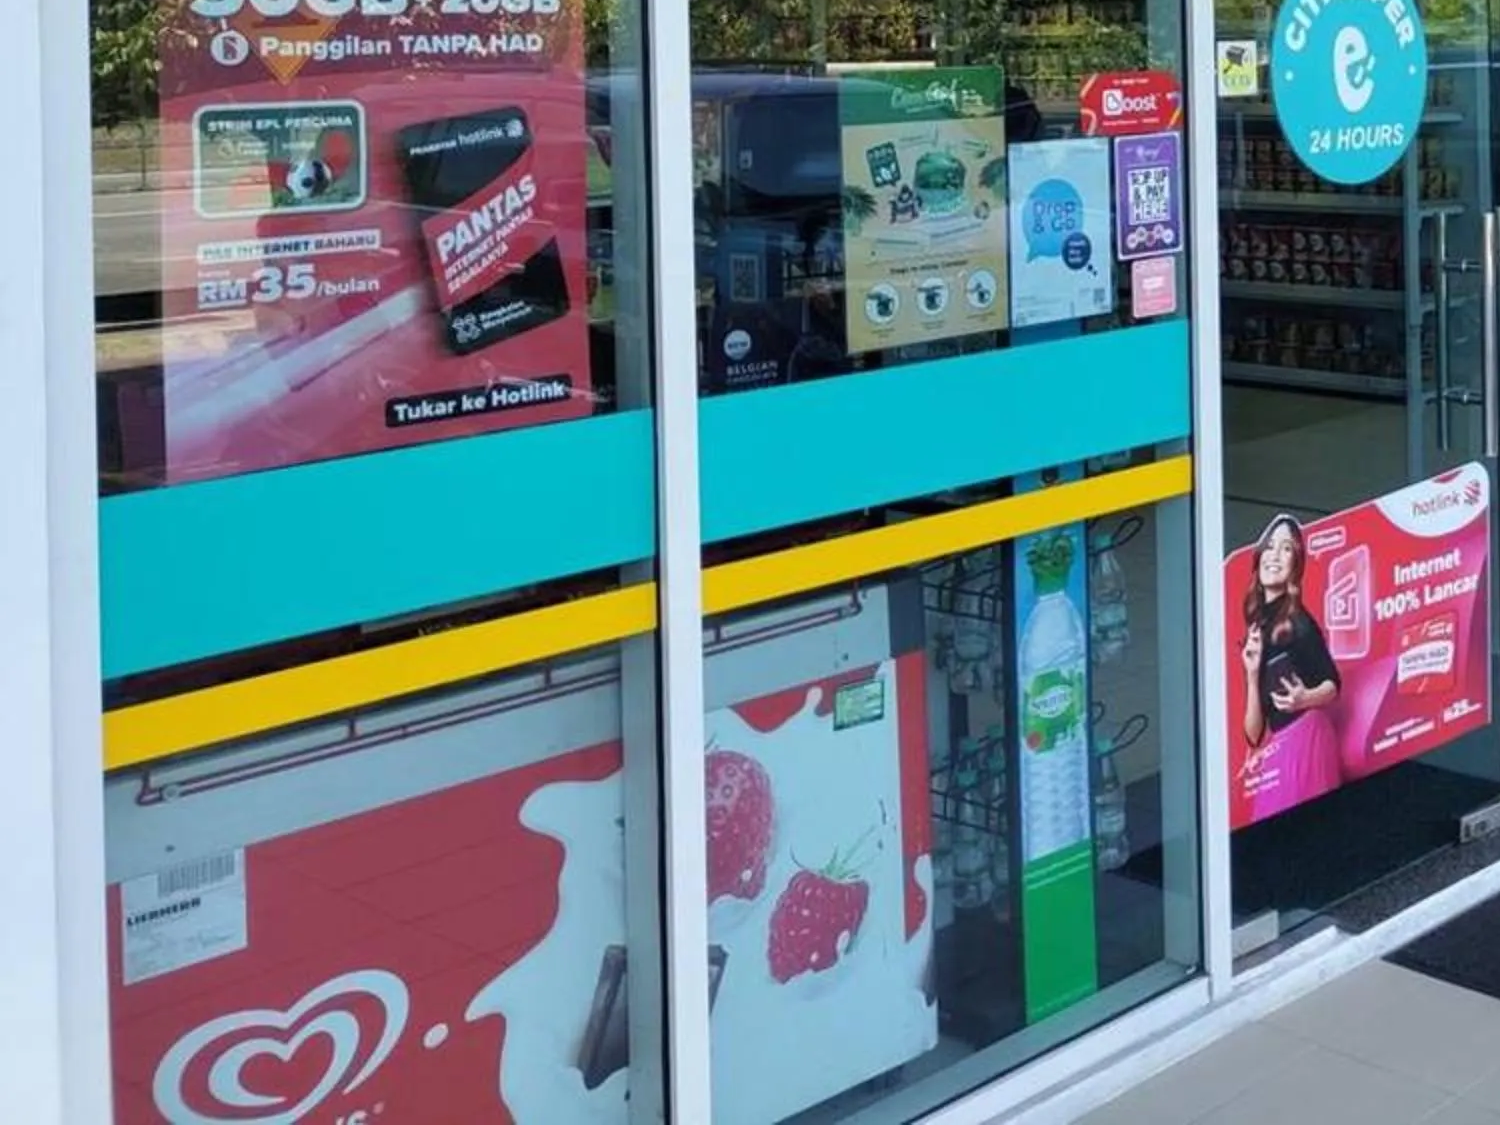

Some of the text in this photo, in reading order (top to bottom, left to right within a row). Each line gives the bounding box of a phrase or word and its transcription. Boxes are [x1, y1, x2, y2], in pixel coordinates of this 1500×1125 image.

[259, 34, 544, 62] Panggilan TANPA HAD
[1103, 89, 1158, 116] Boost
[458, 127, 503, 146] hotlink
[1310, 123, 1404, 154] 24 HOURS
[435, 174, 537, 264] PANTAS
[1033, 201, 1077, 222] Drop
[1051, 217, 1076, 232] Go
[199, 279, 247, 303] RM
[252, 263, 317, 303] 35
[394, 381, 566, 422] Tukar ke Hotlink
[1411, 489, 1462, 518] hotlink
[1393, 548, 1462, 585] Internet
[1374, 587, 1419, 621] 100%
